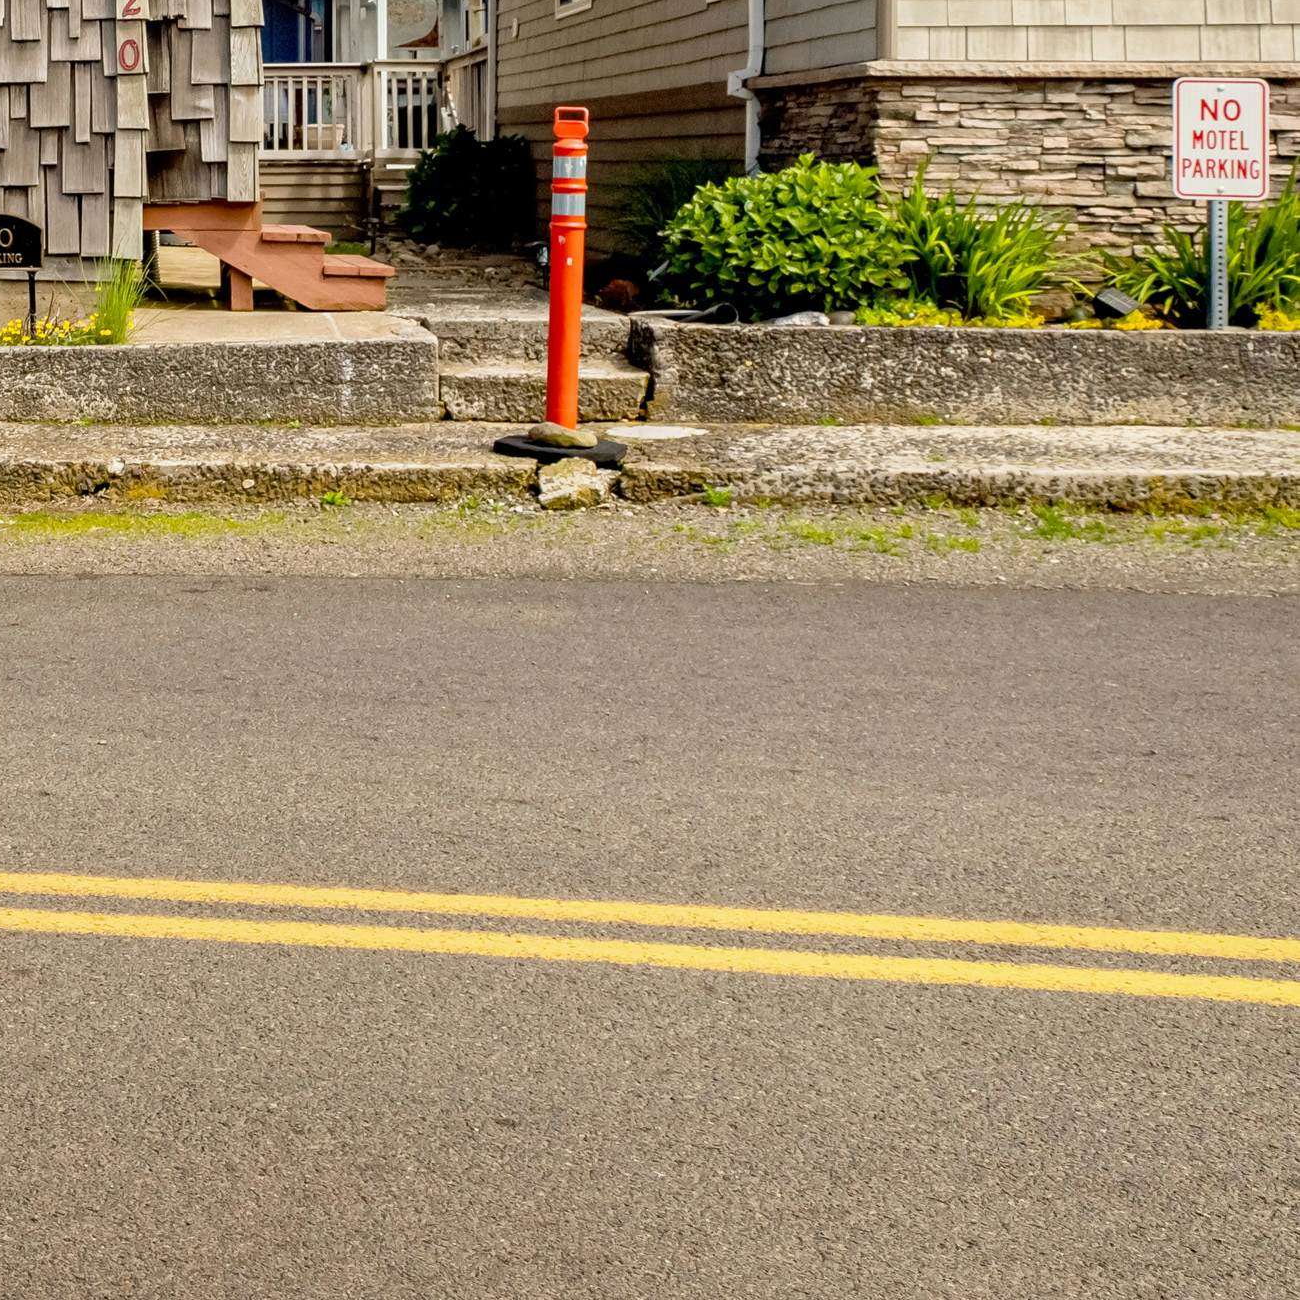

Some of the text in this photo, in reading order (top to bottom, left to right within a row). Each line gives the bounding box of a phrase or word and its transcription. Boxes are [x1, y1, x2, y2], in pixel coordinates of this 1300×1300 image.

[1200, 99, 1241, 122] NO
[1192, 130, 1249, 150] MOTEL
[1182, 158, 1260, 179] PARKING
